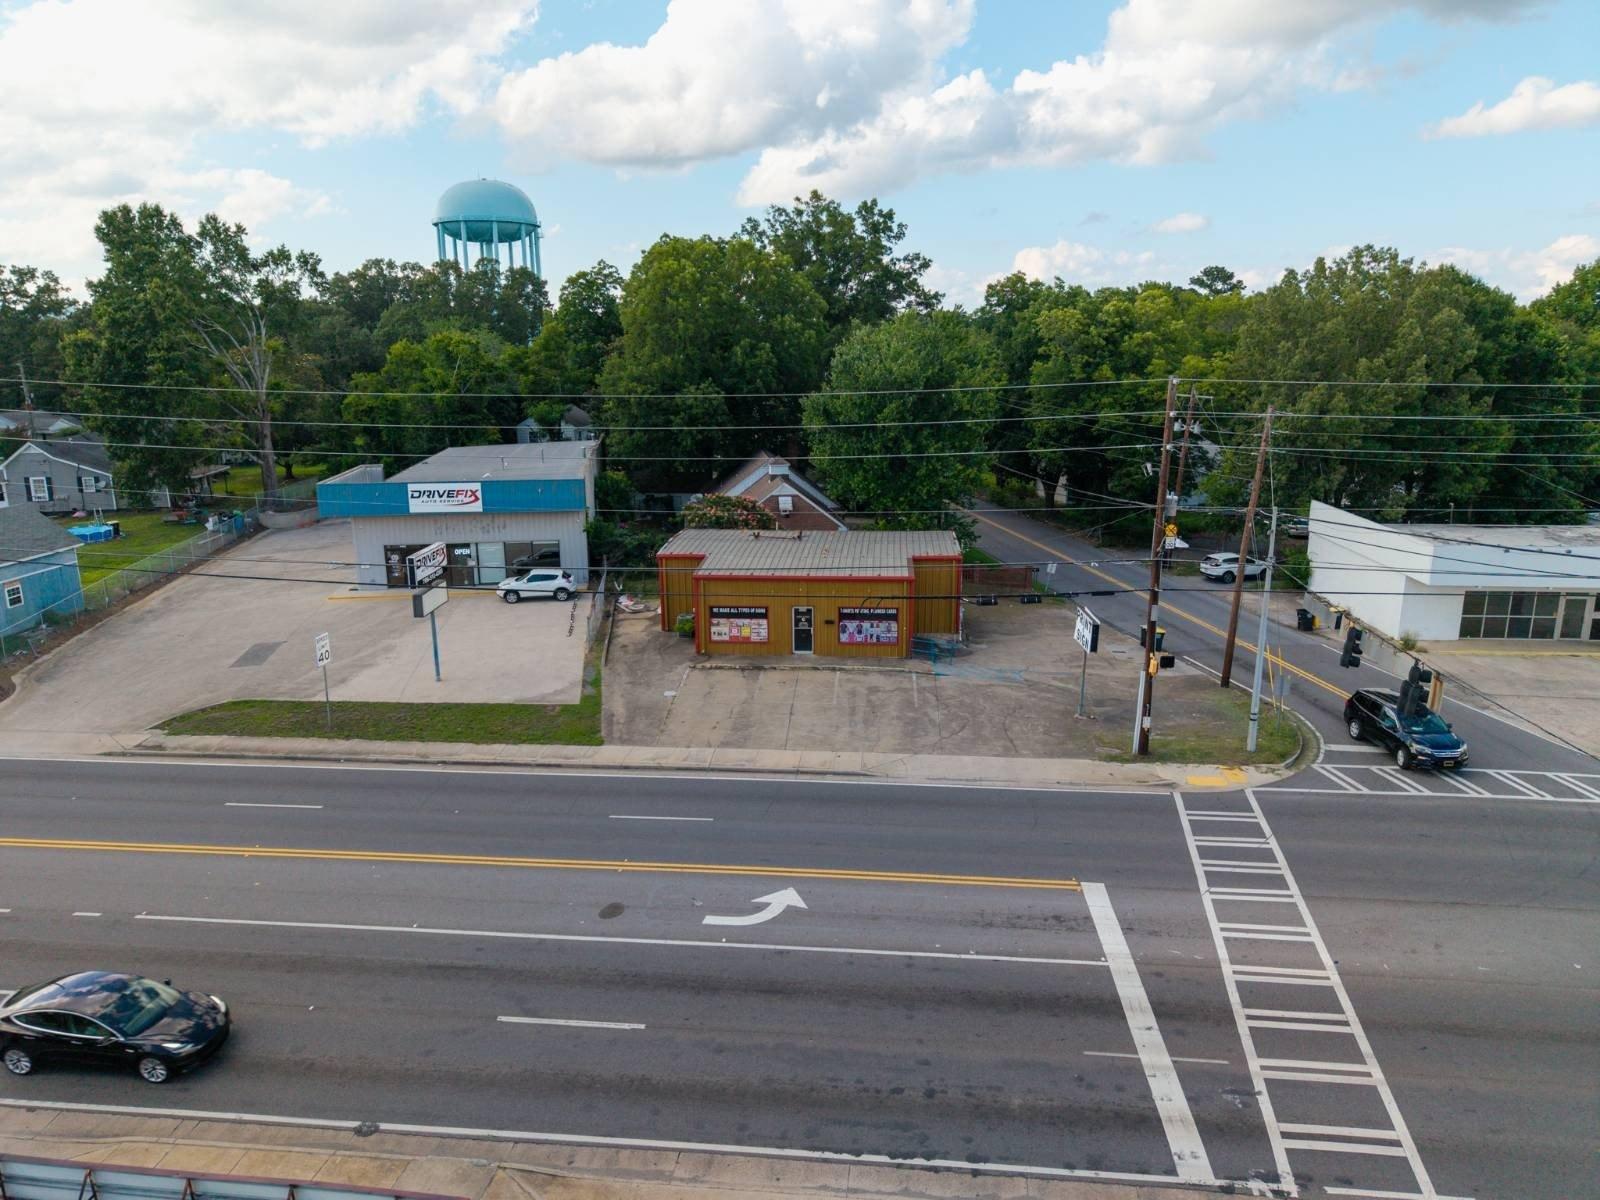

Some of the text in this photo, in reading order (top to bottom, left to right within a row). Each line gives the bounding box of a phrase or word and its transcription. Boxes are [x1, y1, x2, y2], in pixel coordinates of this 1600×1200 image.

[410, 489, 480, 500] DRIVEFIX
[1077, 609, 1092, 634] PRINT
[1076, 629, 1089, 649] SIGN
[318, 649, 330, 662] 40
